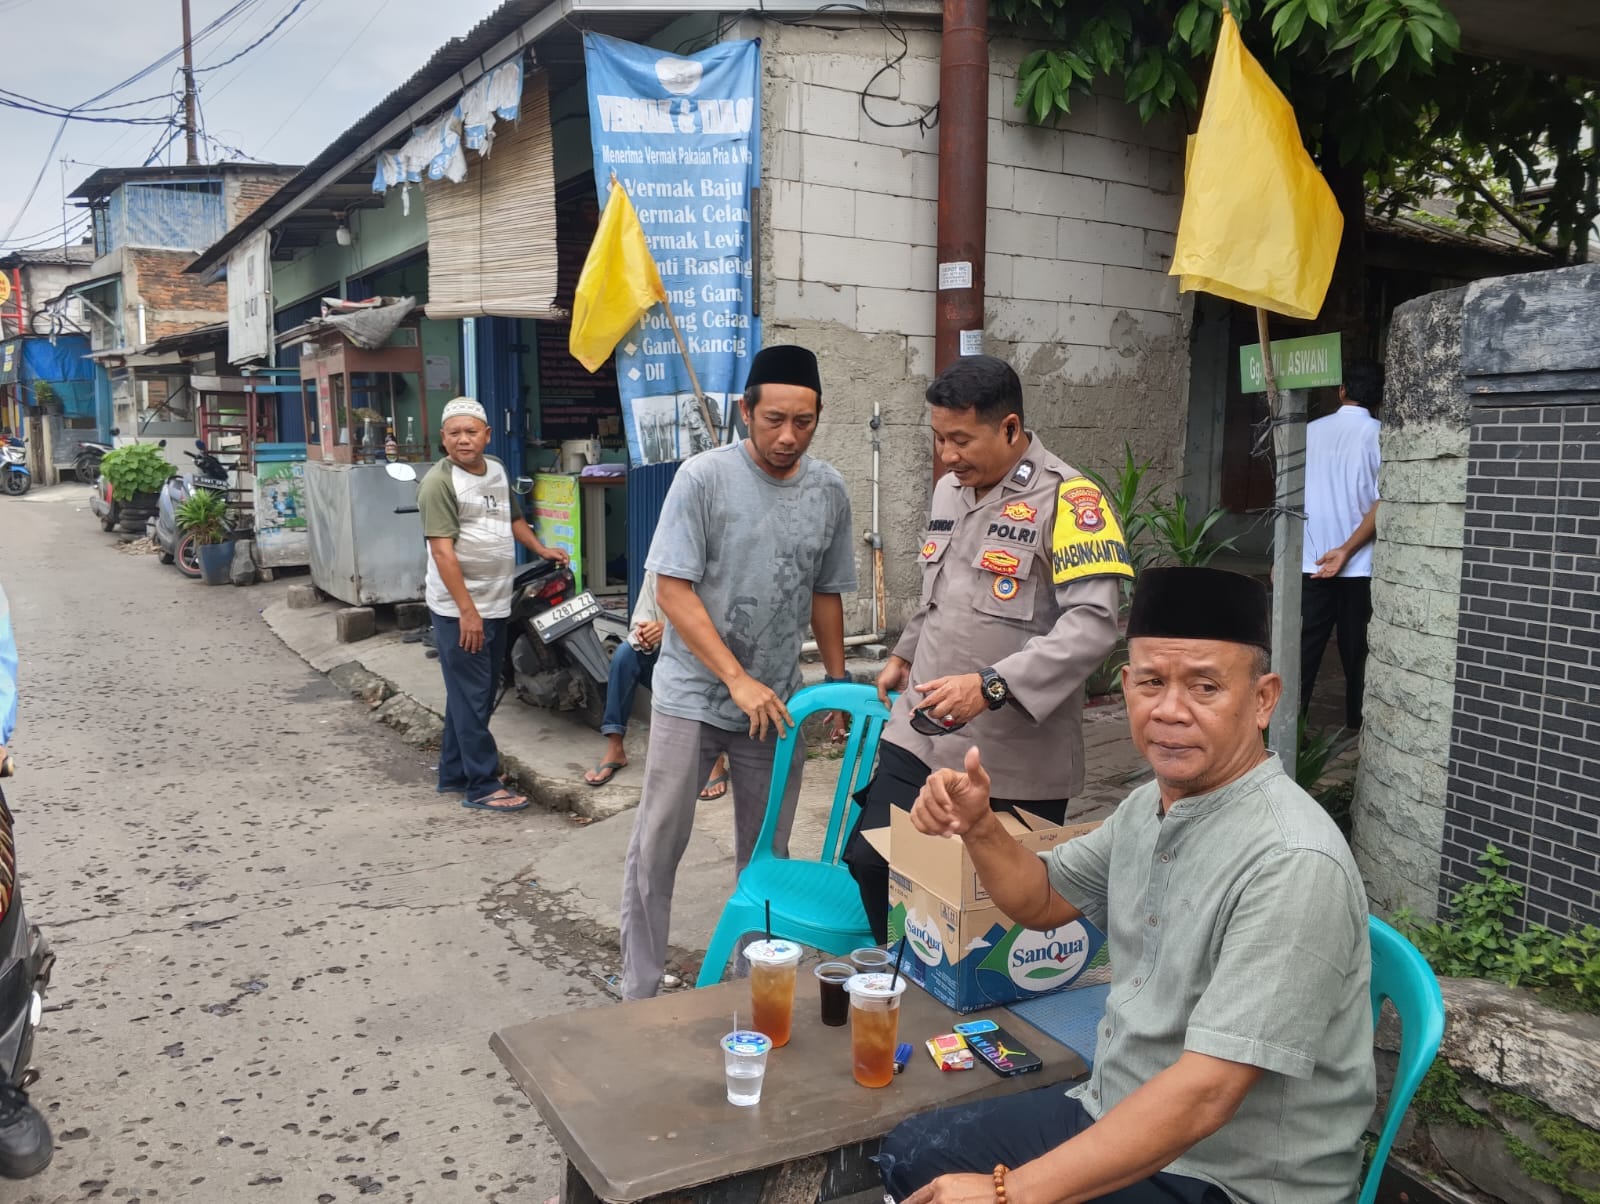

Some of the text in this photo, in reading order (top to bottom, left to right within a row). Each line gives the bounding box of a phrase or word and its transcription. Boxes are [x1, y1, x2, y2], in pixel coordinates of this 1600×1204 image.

[677, 99, 697, 134] &
[602, 145, 644, 164] Menerima
[645, 146, 677, 165] Vermak
[678, 147, 711, 165] Pakaian
[713, 147, 729, 164] Pria
[732, 147, 739, 163] &
[624, 178, 743, 200] Vermak Baju
[646, 231, 698, 250] ermak
[1288, 347, 1329, 376] ASWANI
[986, 523, 1038, 544] POLRI
[906, 918, 941, 952] SanQua
[1012, 938, 1085, 967] SanQua
